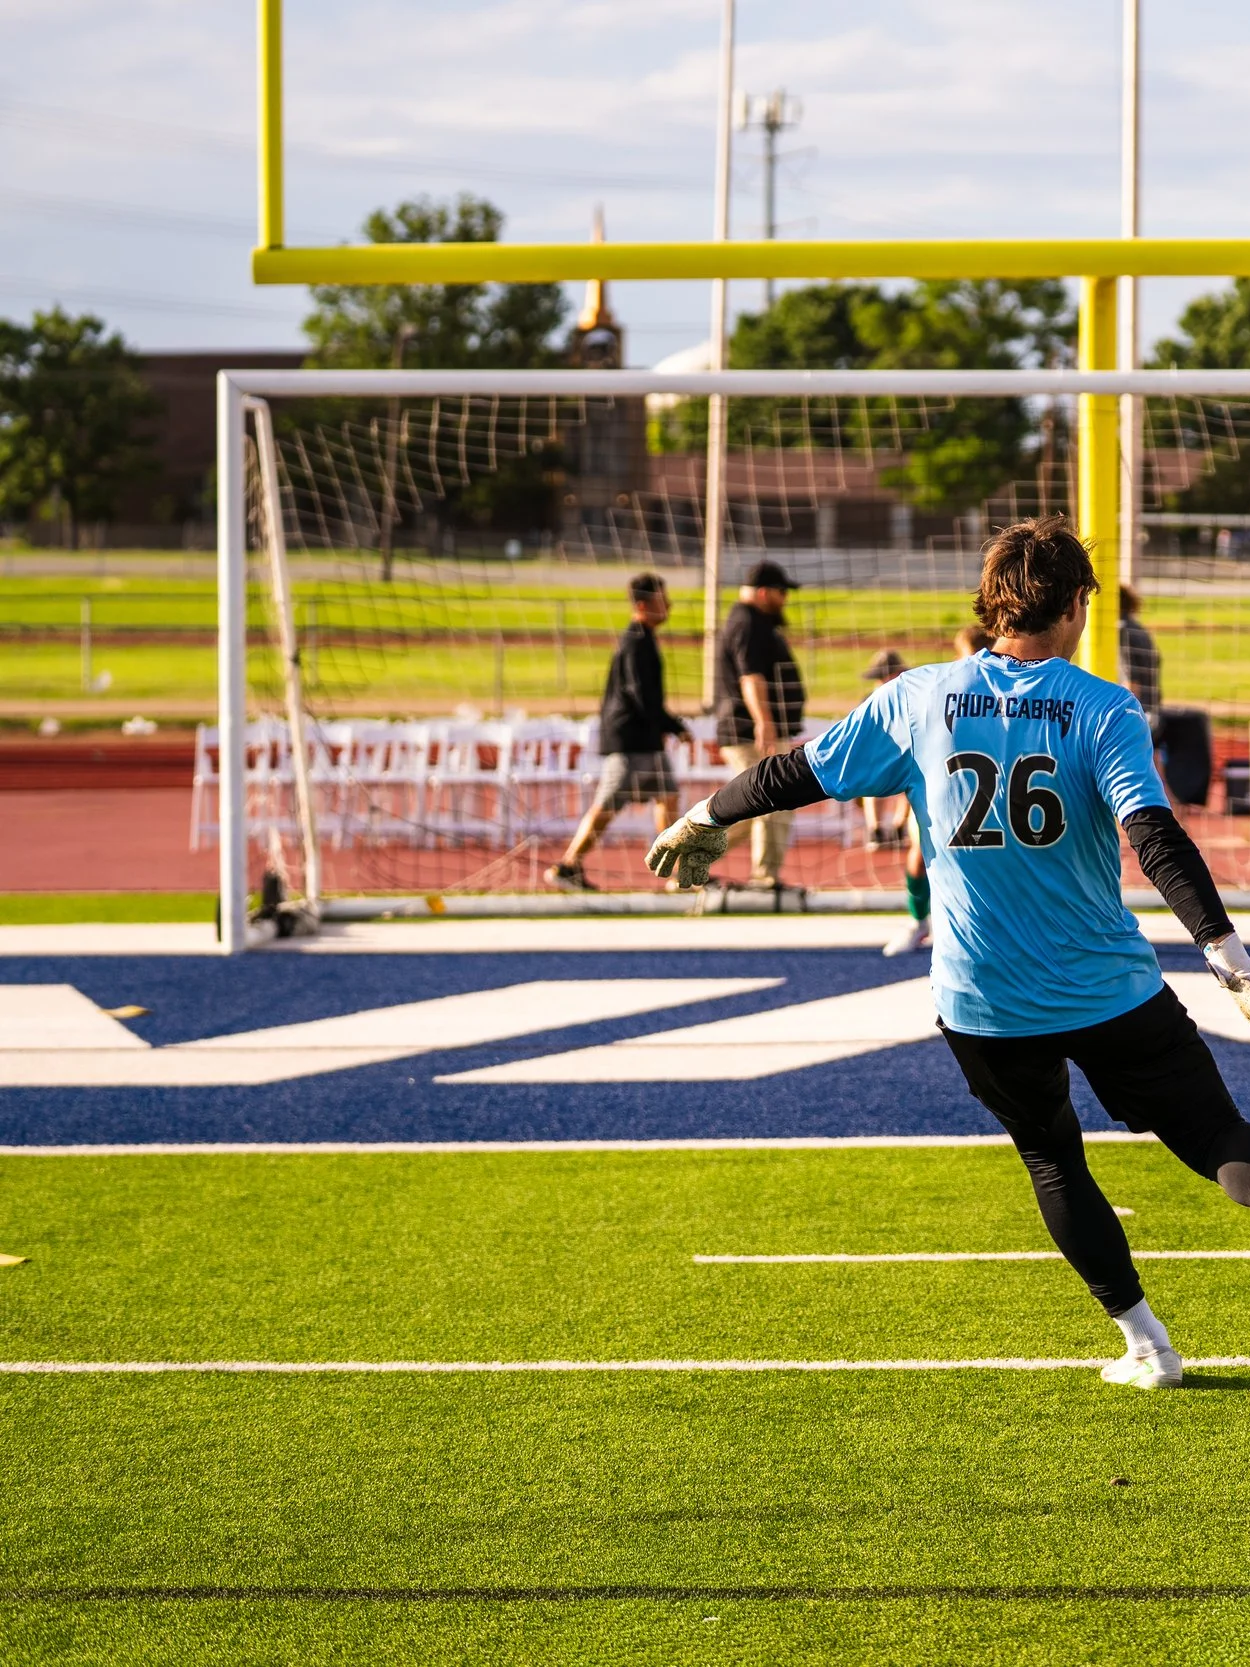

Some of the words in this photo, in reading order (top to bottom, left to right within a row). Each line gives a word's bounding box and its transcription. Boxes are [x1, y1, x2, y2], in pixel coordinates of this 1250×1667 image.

[1000, 654, 1020, 667] NIKE
[944, 692, 1075, 739] CHUPACABRAS
[945, 751, 1067, 848] 26
